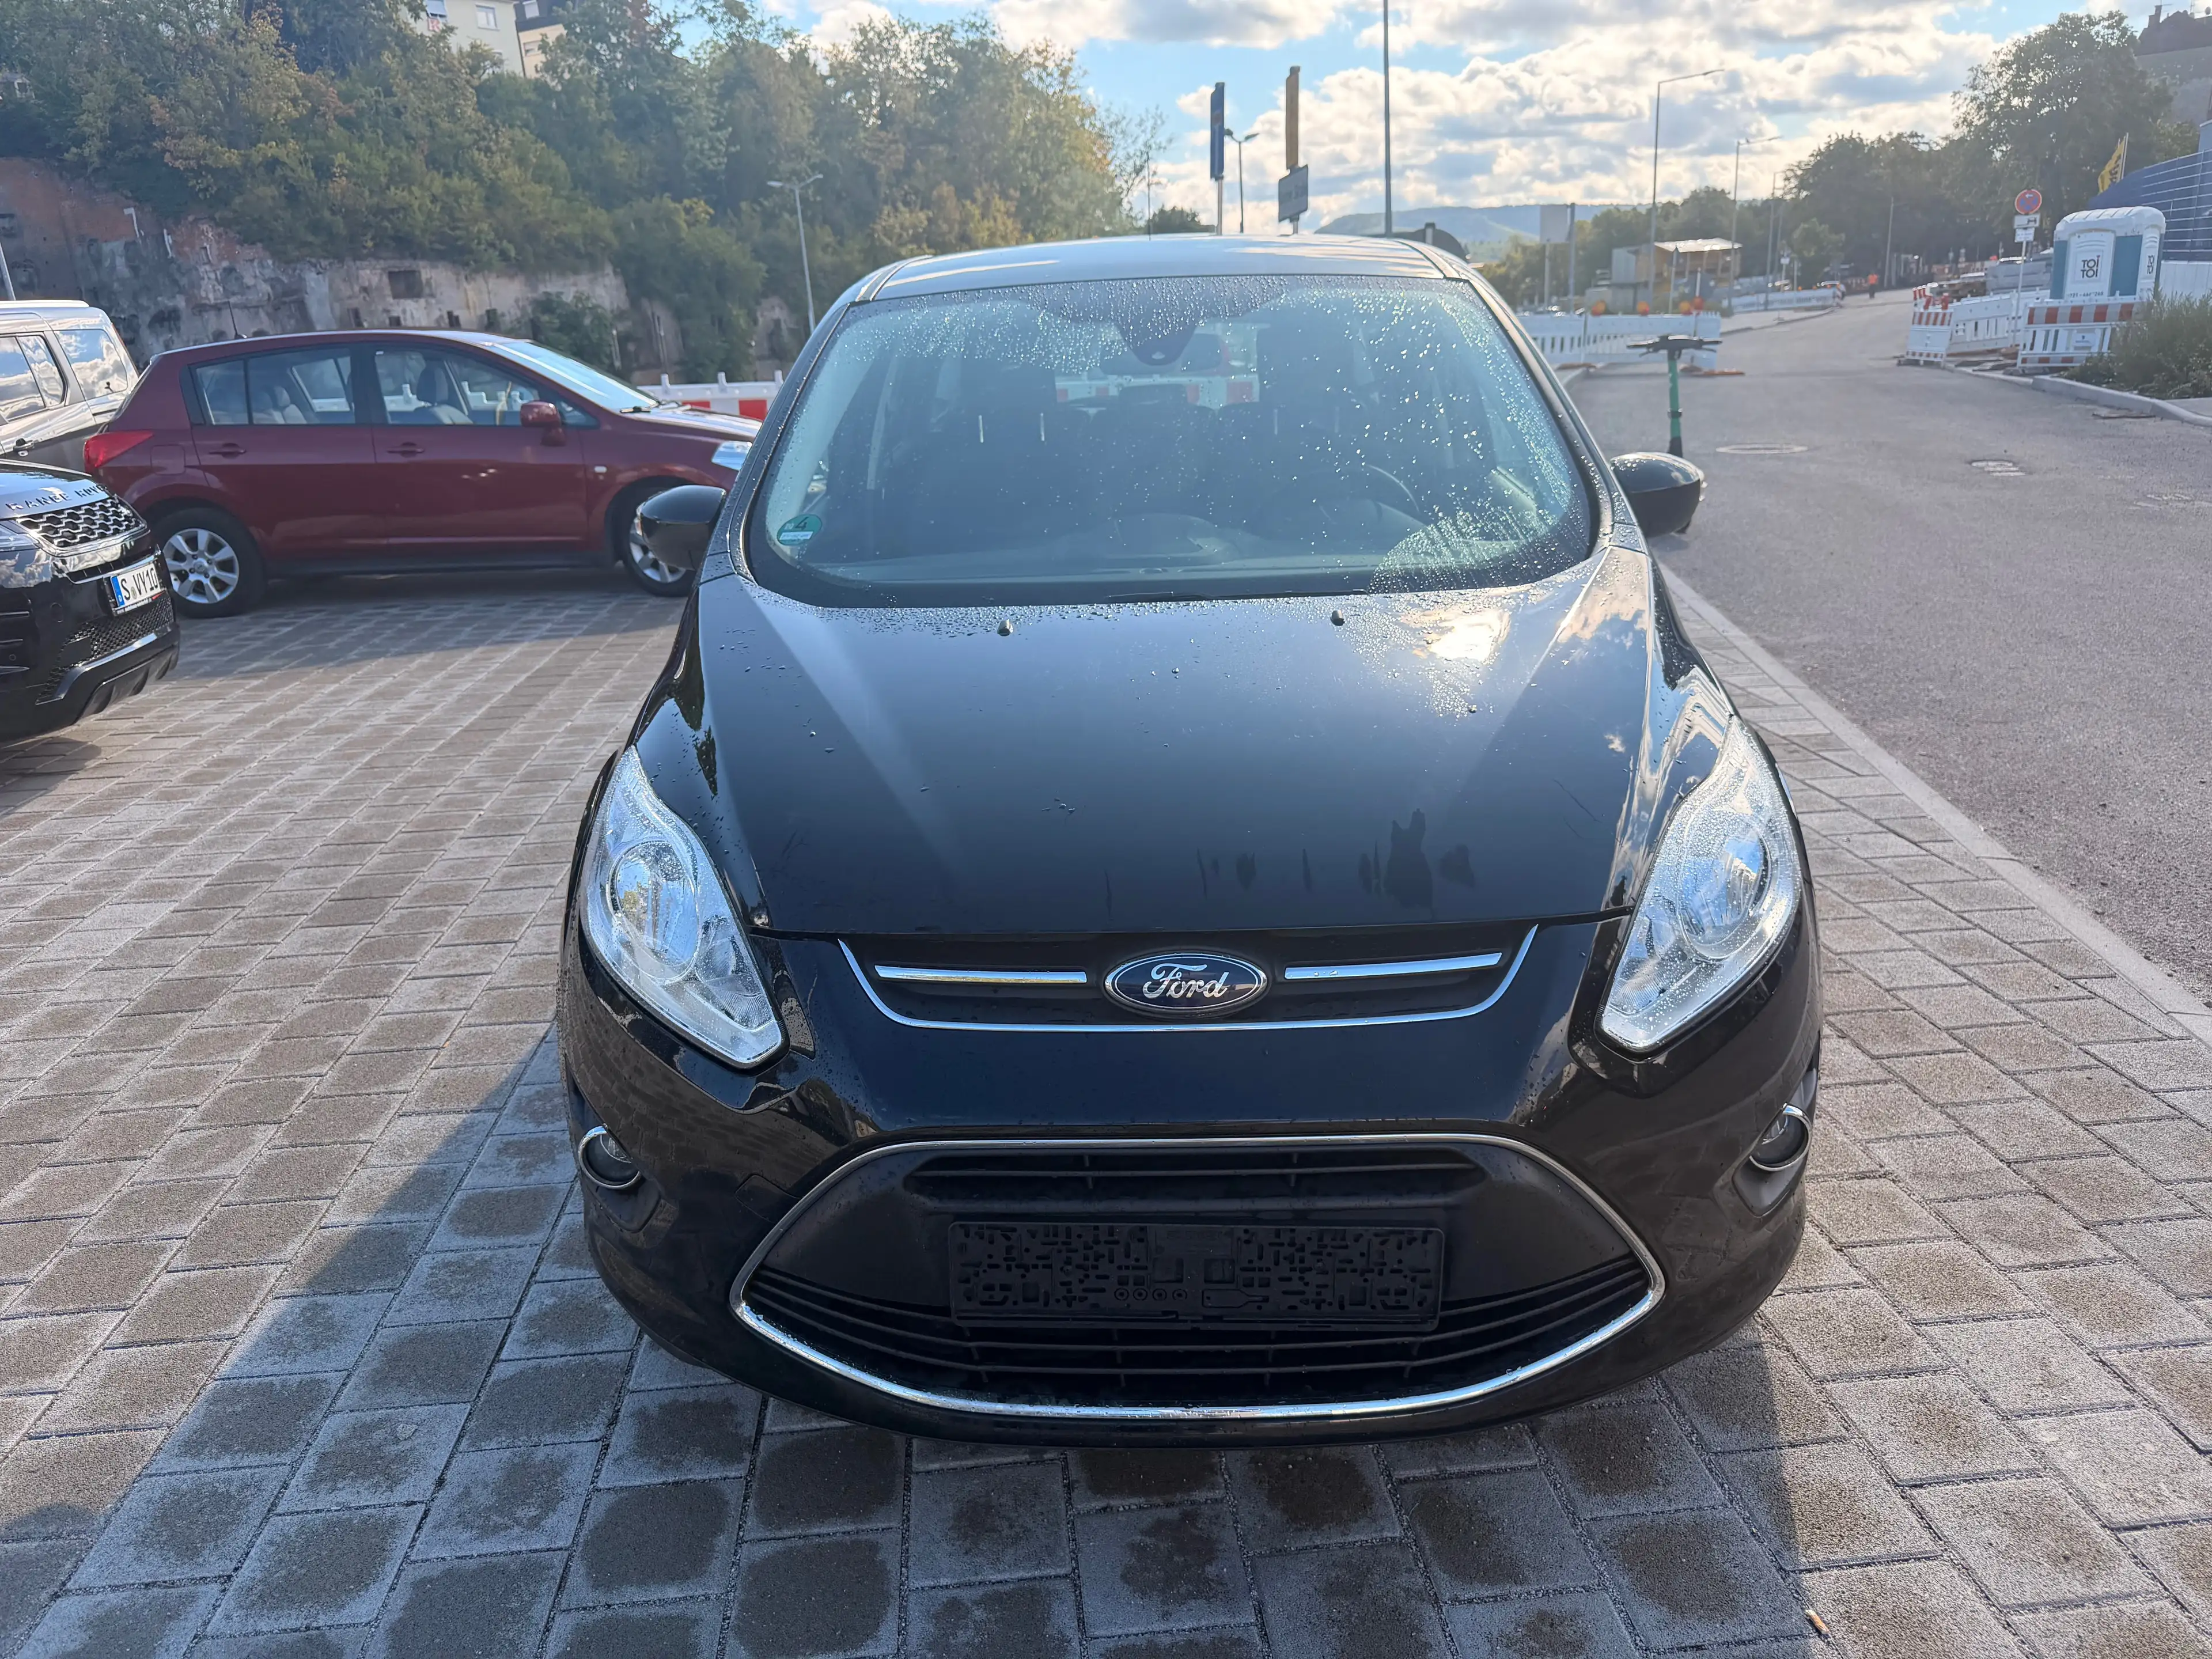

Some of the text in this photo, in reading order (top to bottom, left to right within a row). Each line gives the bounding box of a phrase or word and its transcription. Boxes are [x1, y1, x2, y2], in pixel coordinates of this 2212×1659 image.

[2081, 255, 2101, 269] TOI
[2081, 268, 2099, 279] TOI
[120, 578, 131, 601] S
[1142, 963, 1229, 999] Ford
